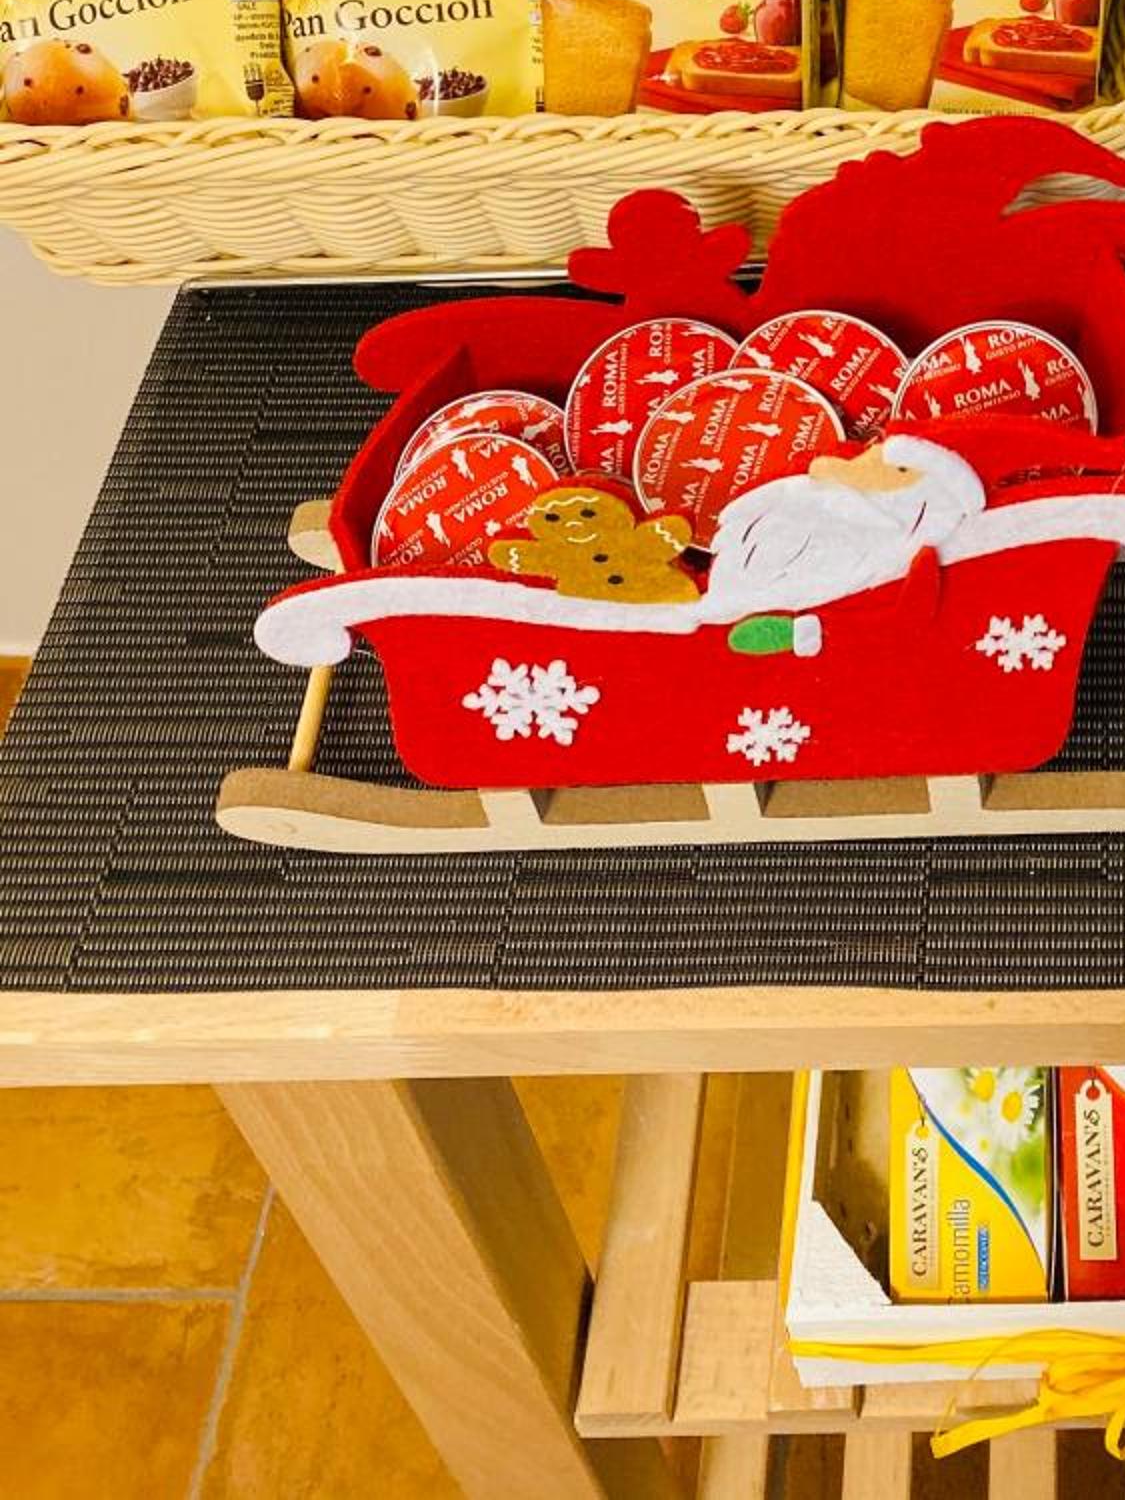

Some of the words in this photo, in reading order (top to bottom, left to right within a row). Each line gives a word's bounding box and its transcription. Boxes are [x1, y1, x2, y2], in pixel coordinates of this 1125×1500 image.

[0, 17, 41, 42] an
[649, 324, 662, 356] RO
[692, 349, 705, 377] MA
[603, 350, 618, 406] ROMA
[829, 342, 871, 392] ROMA
[1045, 354, 1074, 376] RO
[756, 374, 784, 415] ROM
[952, 376, 1013, 409] ROMA
[698, 393, 731, 448] ROMA
[639, 428, 675, 486] ROMA
[394, 472, 450, 519] ROMA
[451, 478, 510, 528] ROMA
[1084, 1109, 1104, 1247] CARAVAN'S
[911, 1147, 928, 1276] CARAVAN'S
